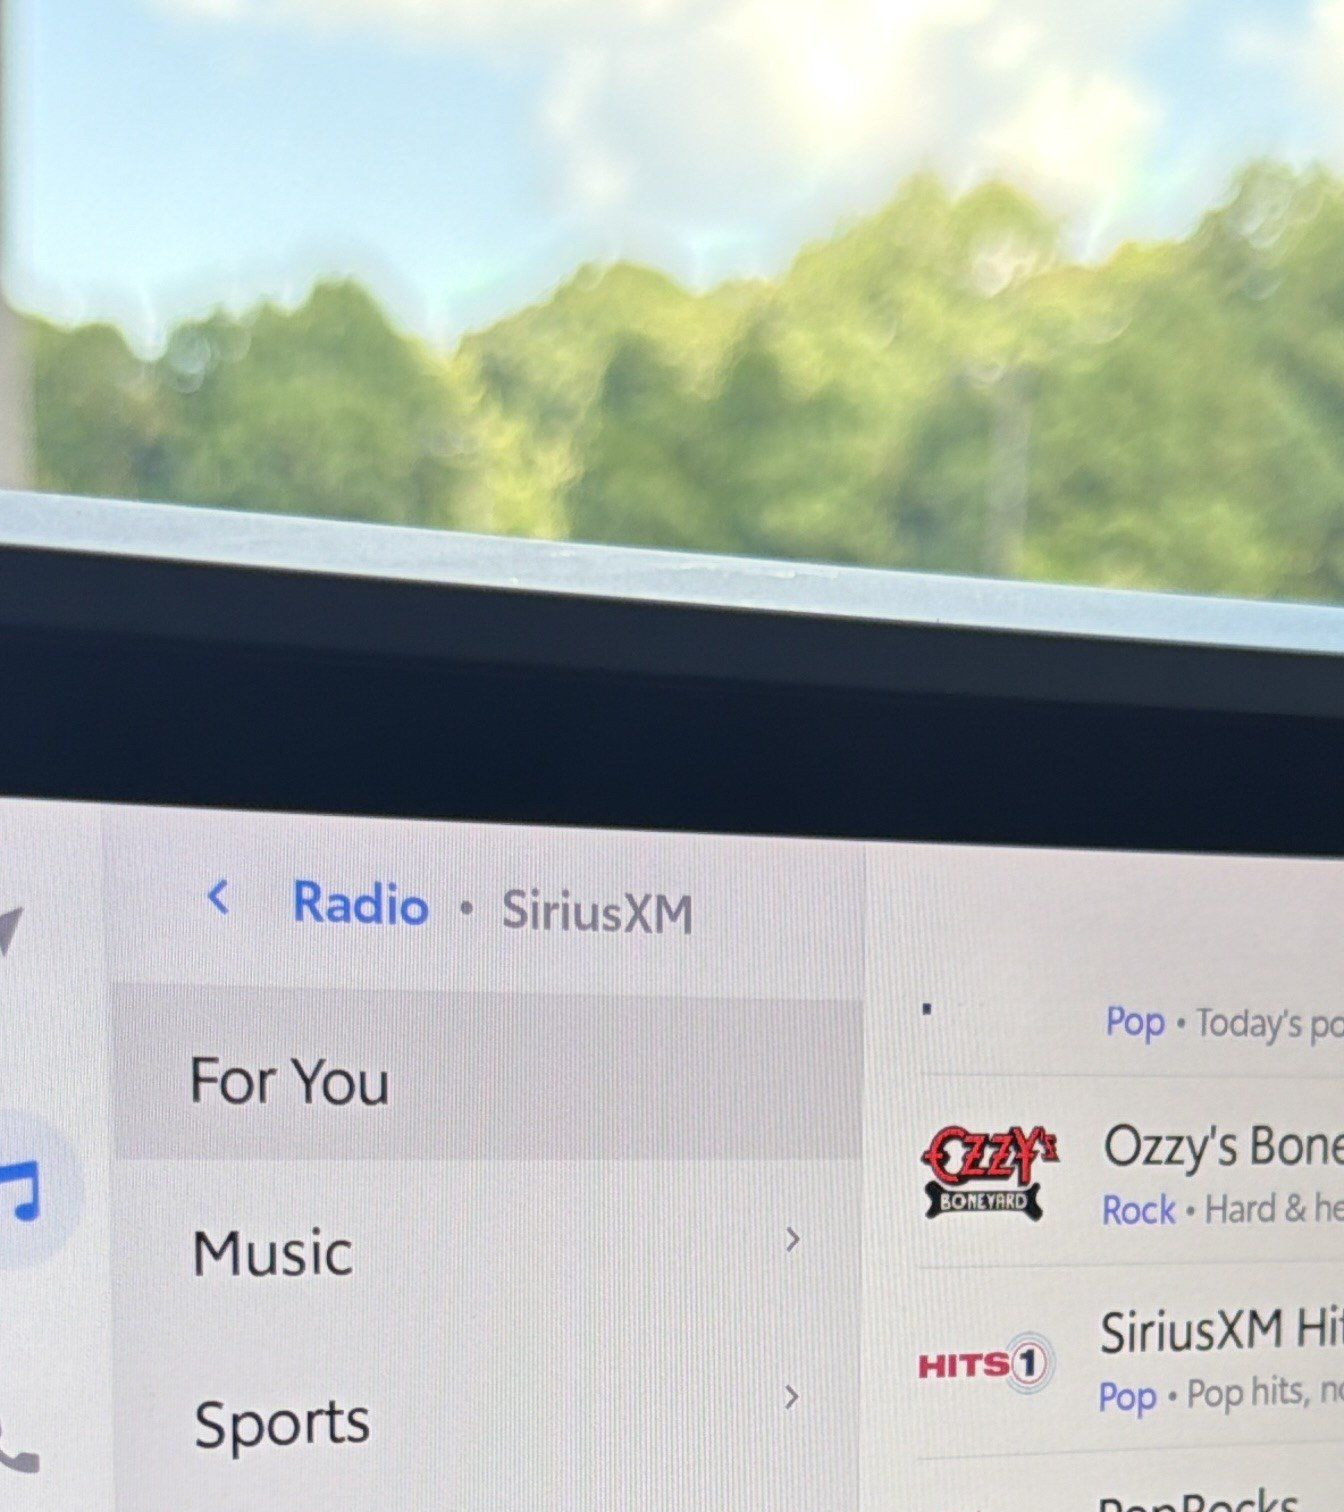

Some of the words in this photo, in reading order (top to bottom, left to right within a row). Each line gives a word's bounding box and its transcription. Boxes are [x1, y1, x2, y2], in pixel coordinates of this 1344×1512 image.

[293, 879, 430, 926] Radio
[502, 888, 693, 937] SiriusXM
[1107, 1006, 1165, 1044] Pop
[1197, 1008, 1302, 1047] Today's
[191, 1056, 277, 1105] For
[290, 1057, 390, 1108] You
[1105, 1122, 1237, 1177] Ozzy's
[940, 1193, 1028, 1210] BONEYARD
[1103, 1194, 1177, 1226] Rock
[1206, 1193, 1276, 1224] Hard
[1285, 1195, 1306, 1223] &
[193, 1225, 353, 1278] Music
[1101, 1309, 1283, 1353] SiriusXM
[919, 1352, 1010, 1378] HITS
[1099, 1381, 1157, 1417] Pop
[1187, 1377, 1244, 1413] Pop
[1252, 1374, 1311, 1411] hits,
[195, 1399, 371, 1460] Sports
